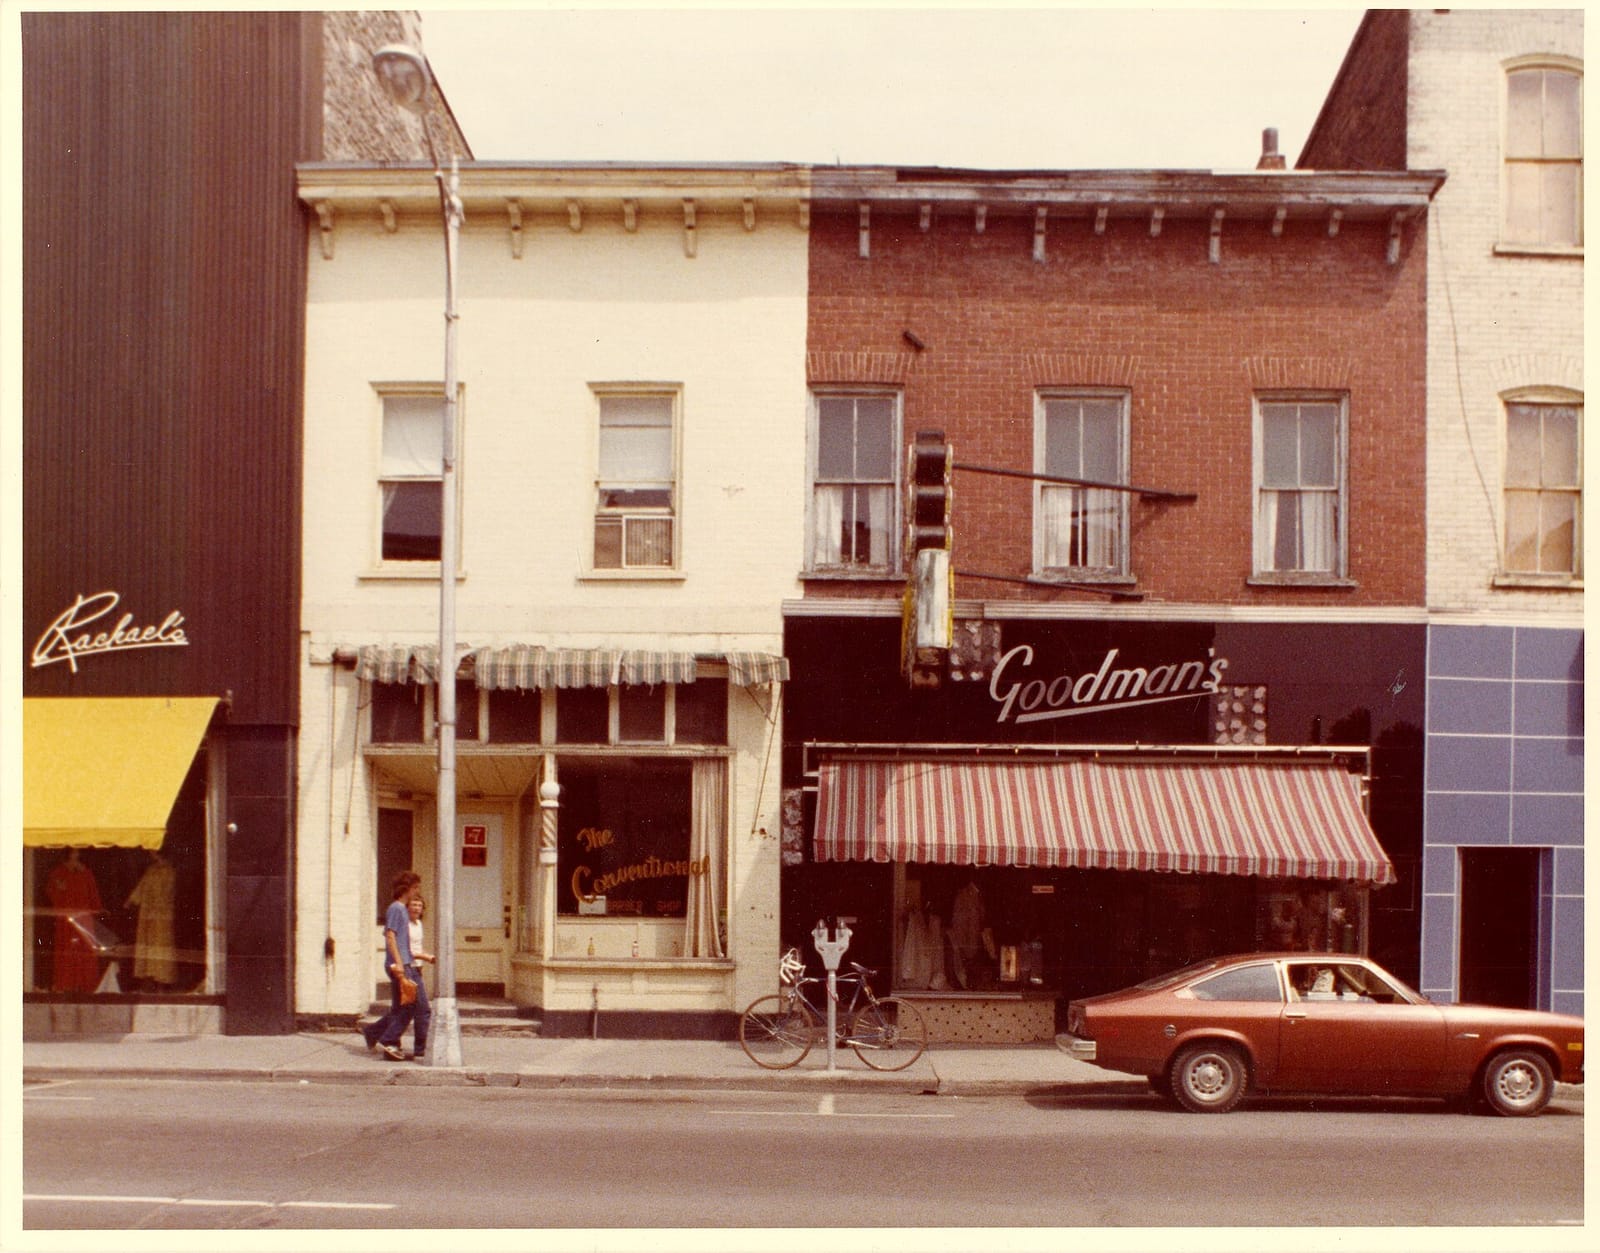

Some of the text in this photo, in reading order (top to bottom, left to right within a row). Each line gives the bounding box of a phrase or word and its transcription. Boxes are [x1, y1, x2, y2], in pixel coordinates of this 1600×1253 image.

[32, 591, 188, 673] Rachael's
[989, 645, 1229, 723] Goodman's
[577, 828, 614, 852] The
[572, 853, 710, 904] Conventional
